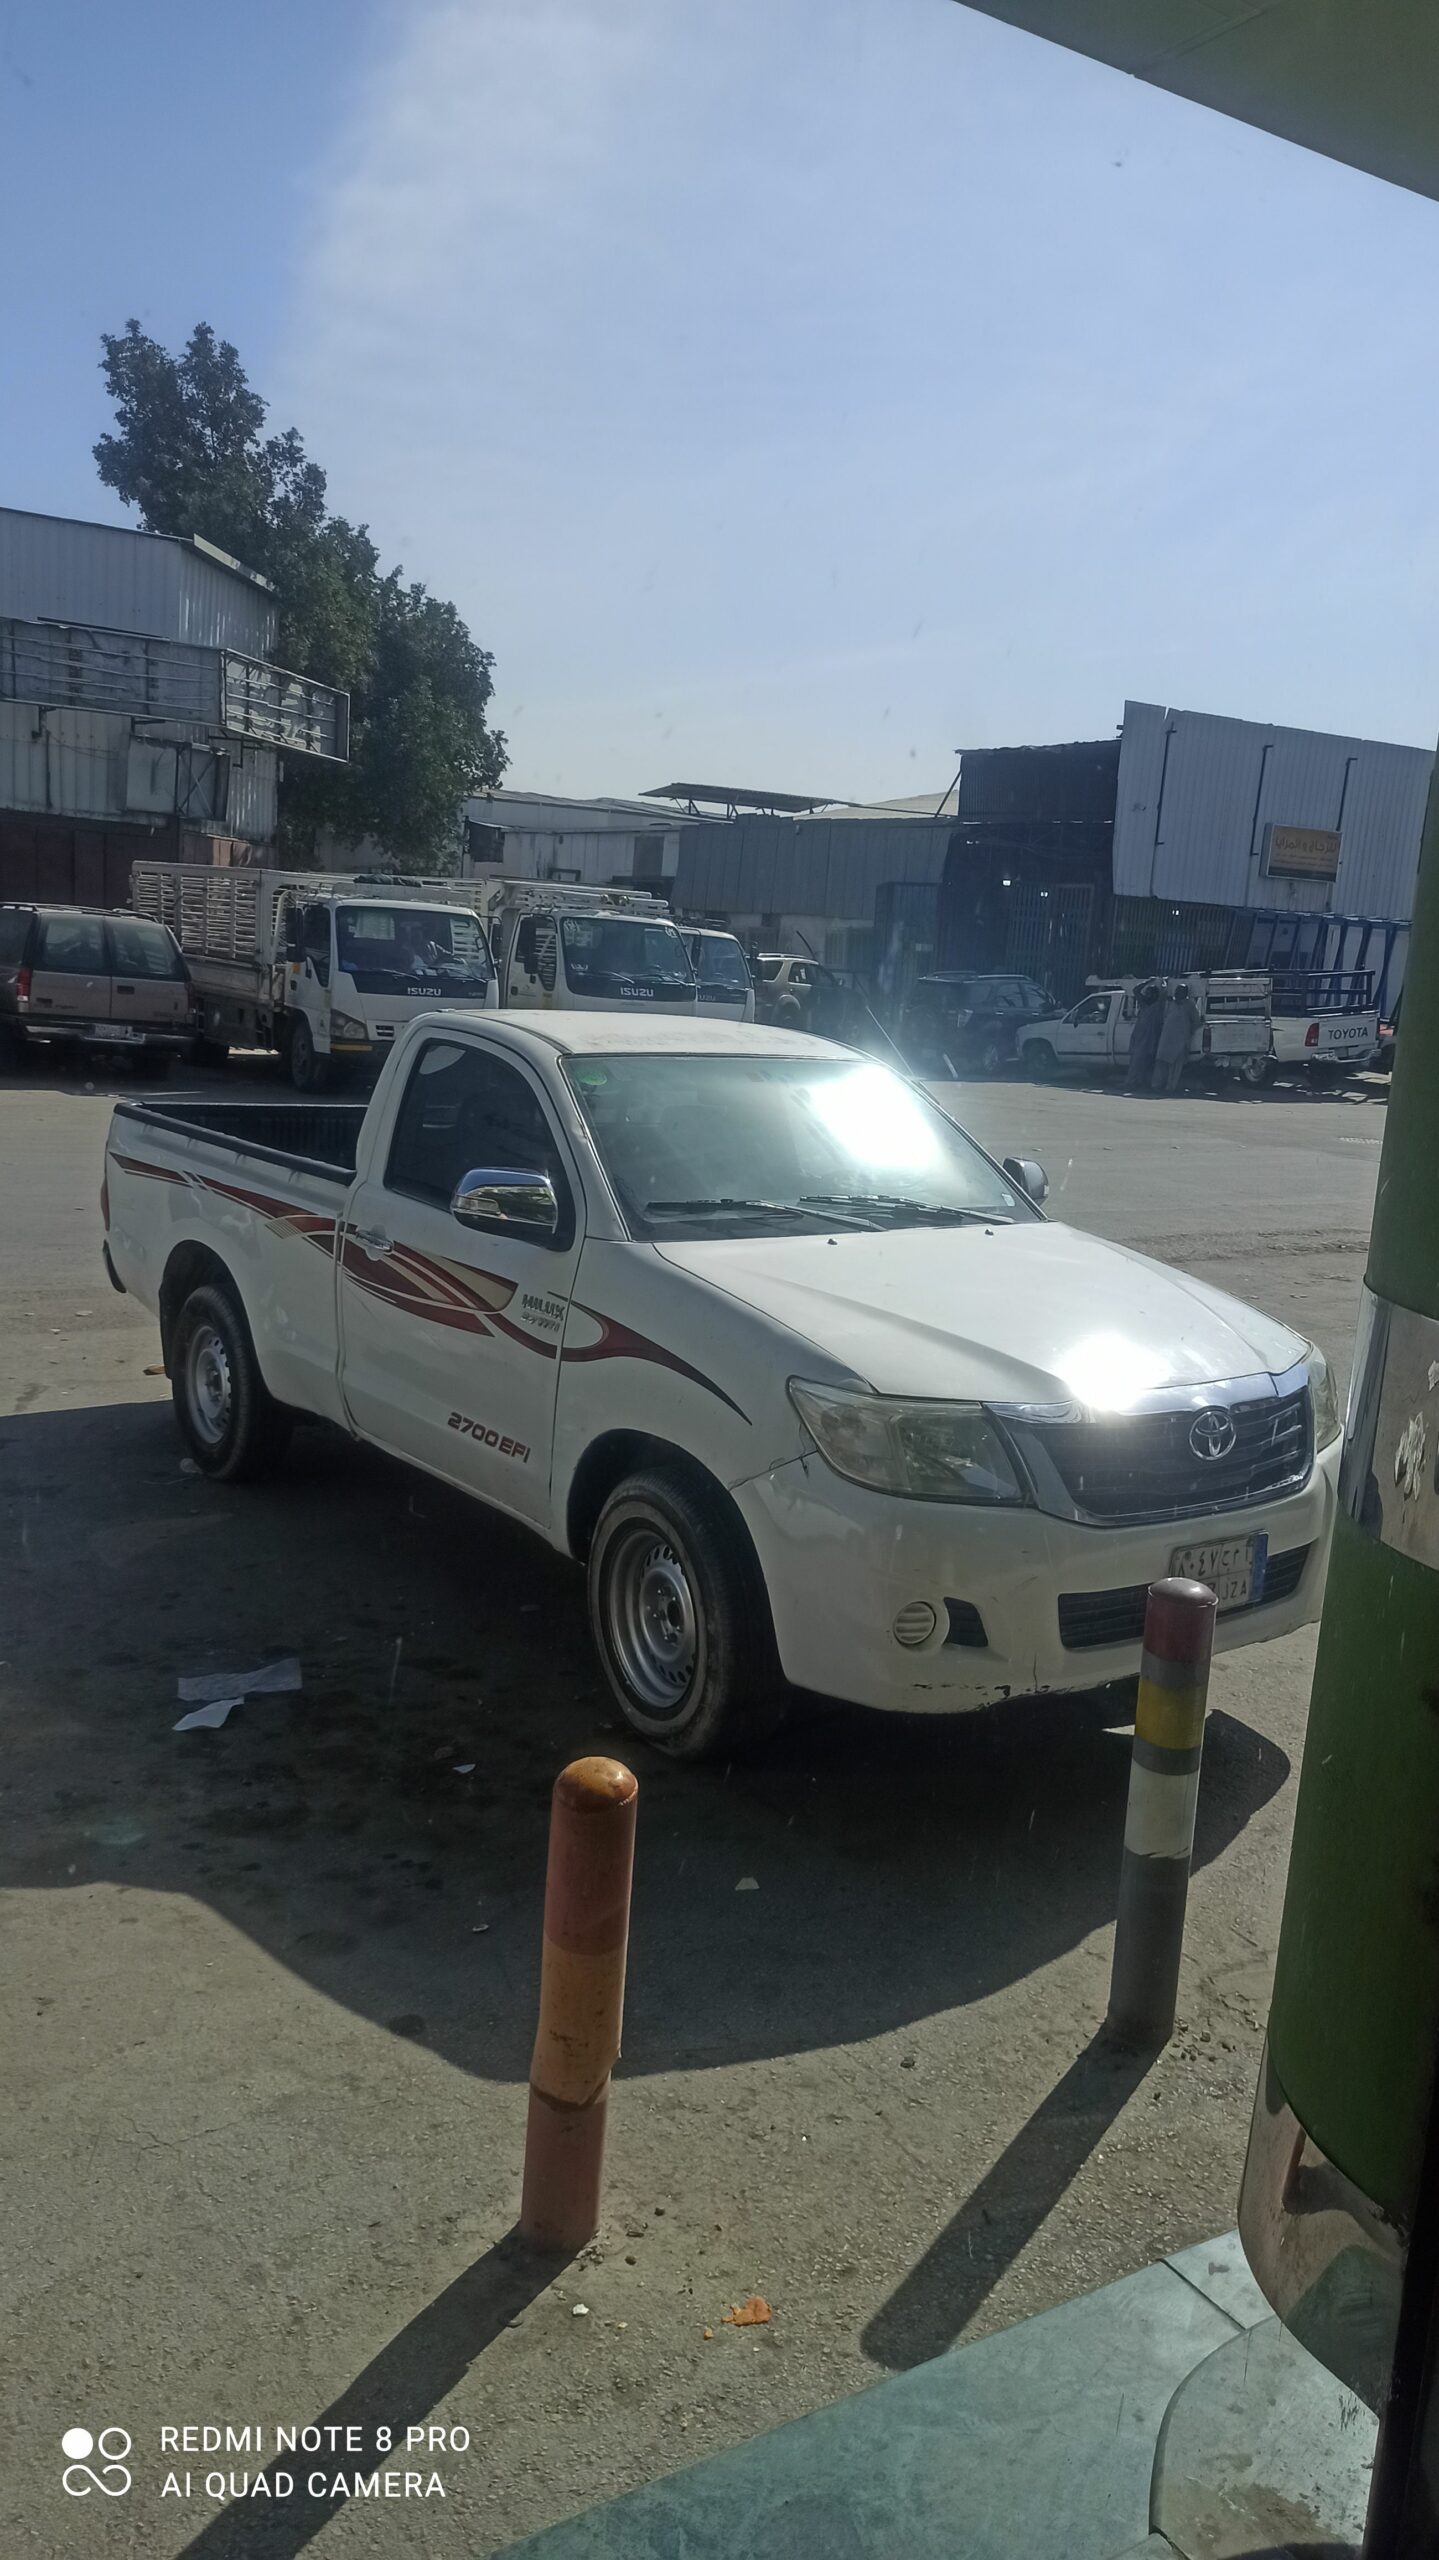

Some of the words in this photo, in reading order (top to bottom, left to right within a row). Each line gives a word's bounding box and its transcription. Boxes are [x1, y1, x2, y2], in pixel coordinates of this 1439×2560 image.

[407, 986, 441, 996] ISUZU
[620, 987, 654, 997] ISUZU
[1328, 1027, 1369, 1040] TOYOTA
[447, 1411, 499, 1449] 2700
[1222, 1579, 1247, 1600] JZA
